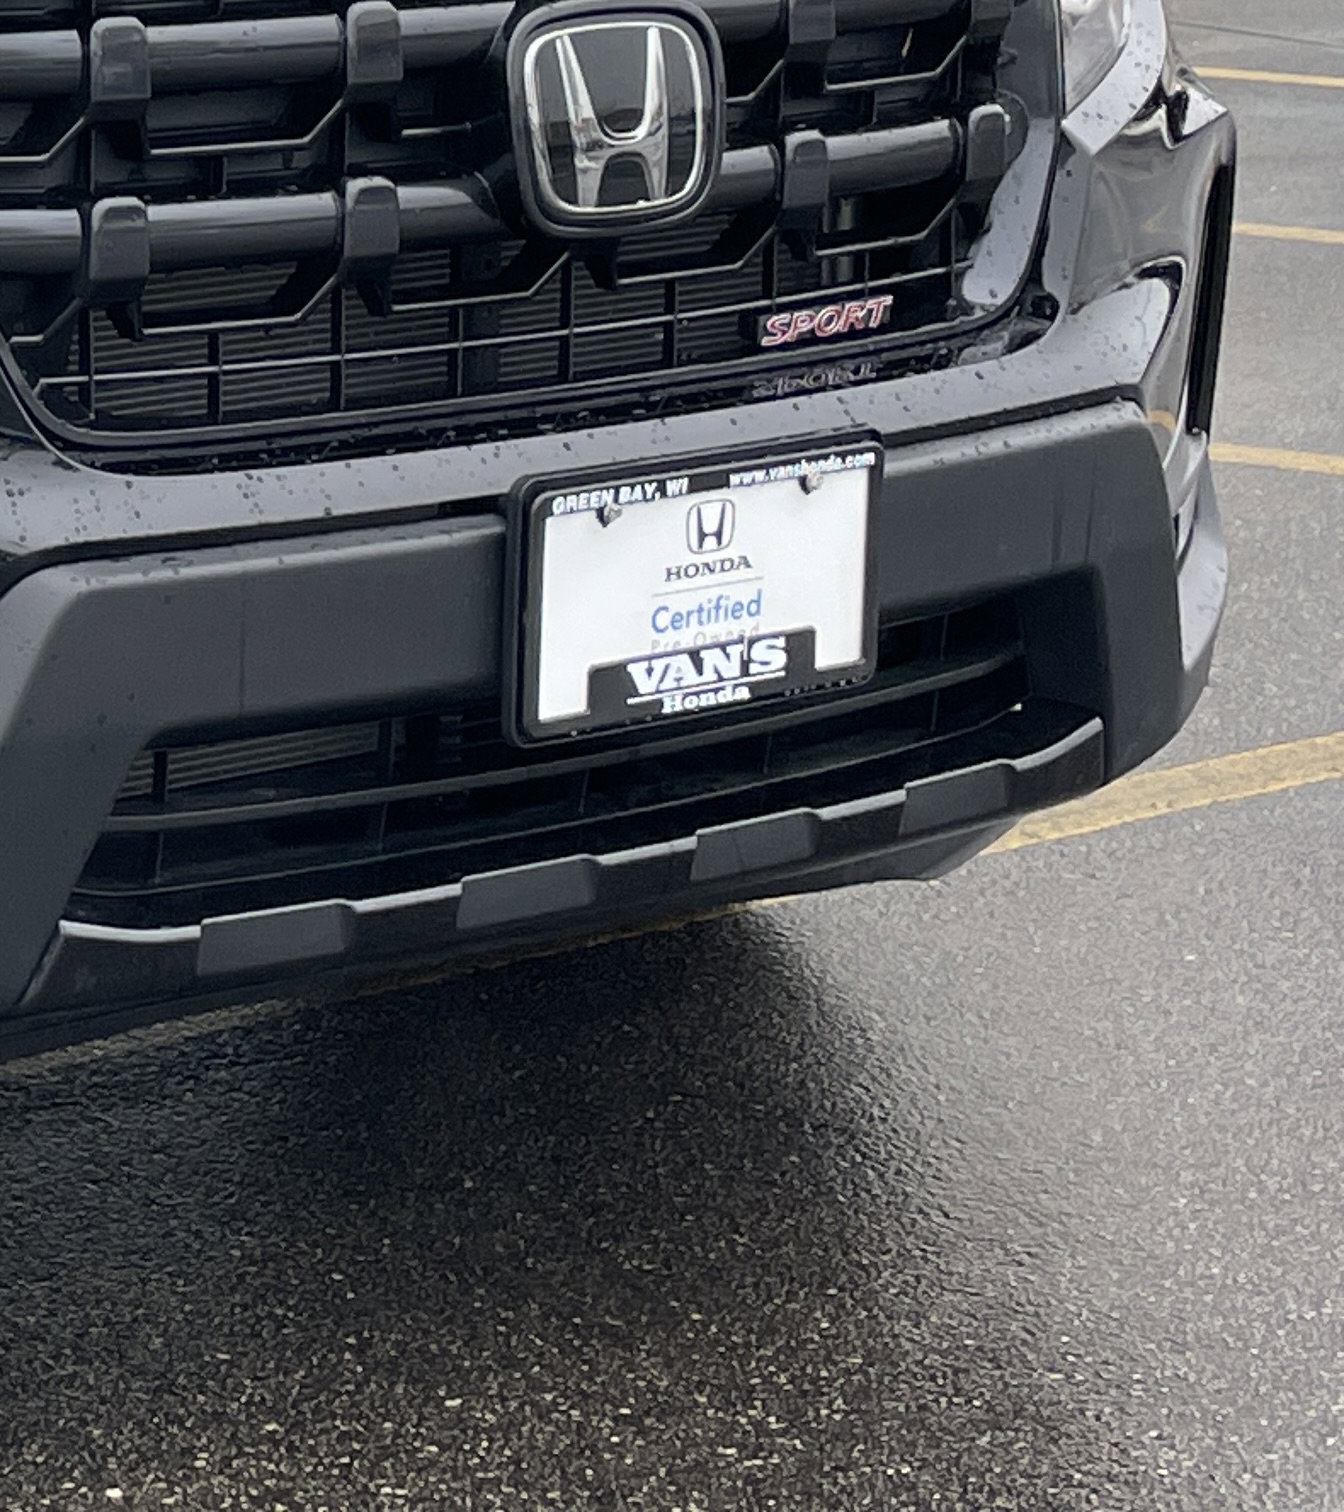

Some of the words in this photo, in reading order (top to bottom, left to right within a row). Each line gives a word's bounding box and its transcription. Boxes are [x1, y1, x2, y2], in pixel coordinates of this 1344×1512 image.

[761, 295, 894, 347] SPORT
[551, 487, 615, 516] GREEN
[618, 480, 661, 505] BAY,
[665, 477, 689, 498] WI
[664, 555, 753, 582] HONDA
[650, 588, 763, 634] Certified
[660, 683, 752, 715] Honda
